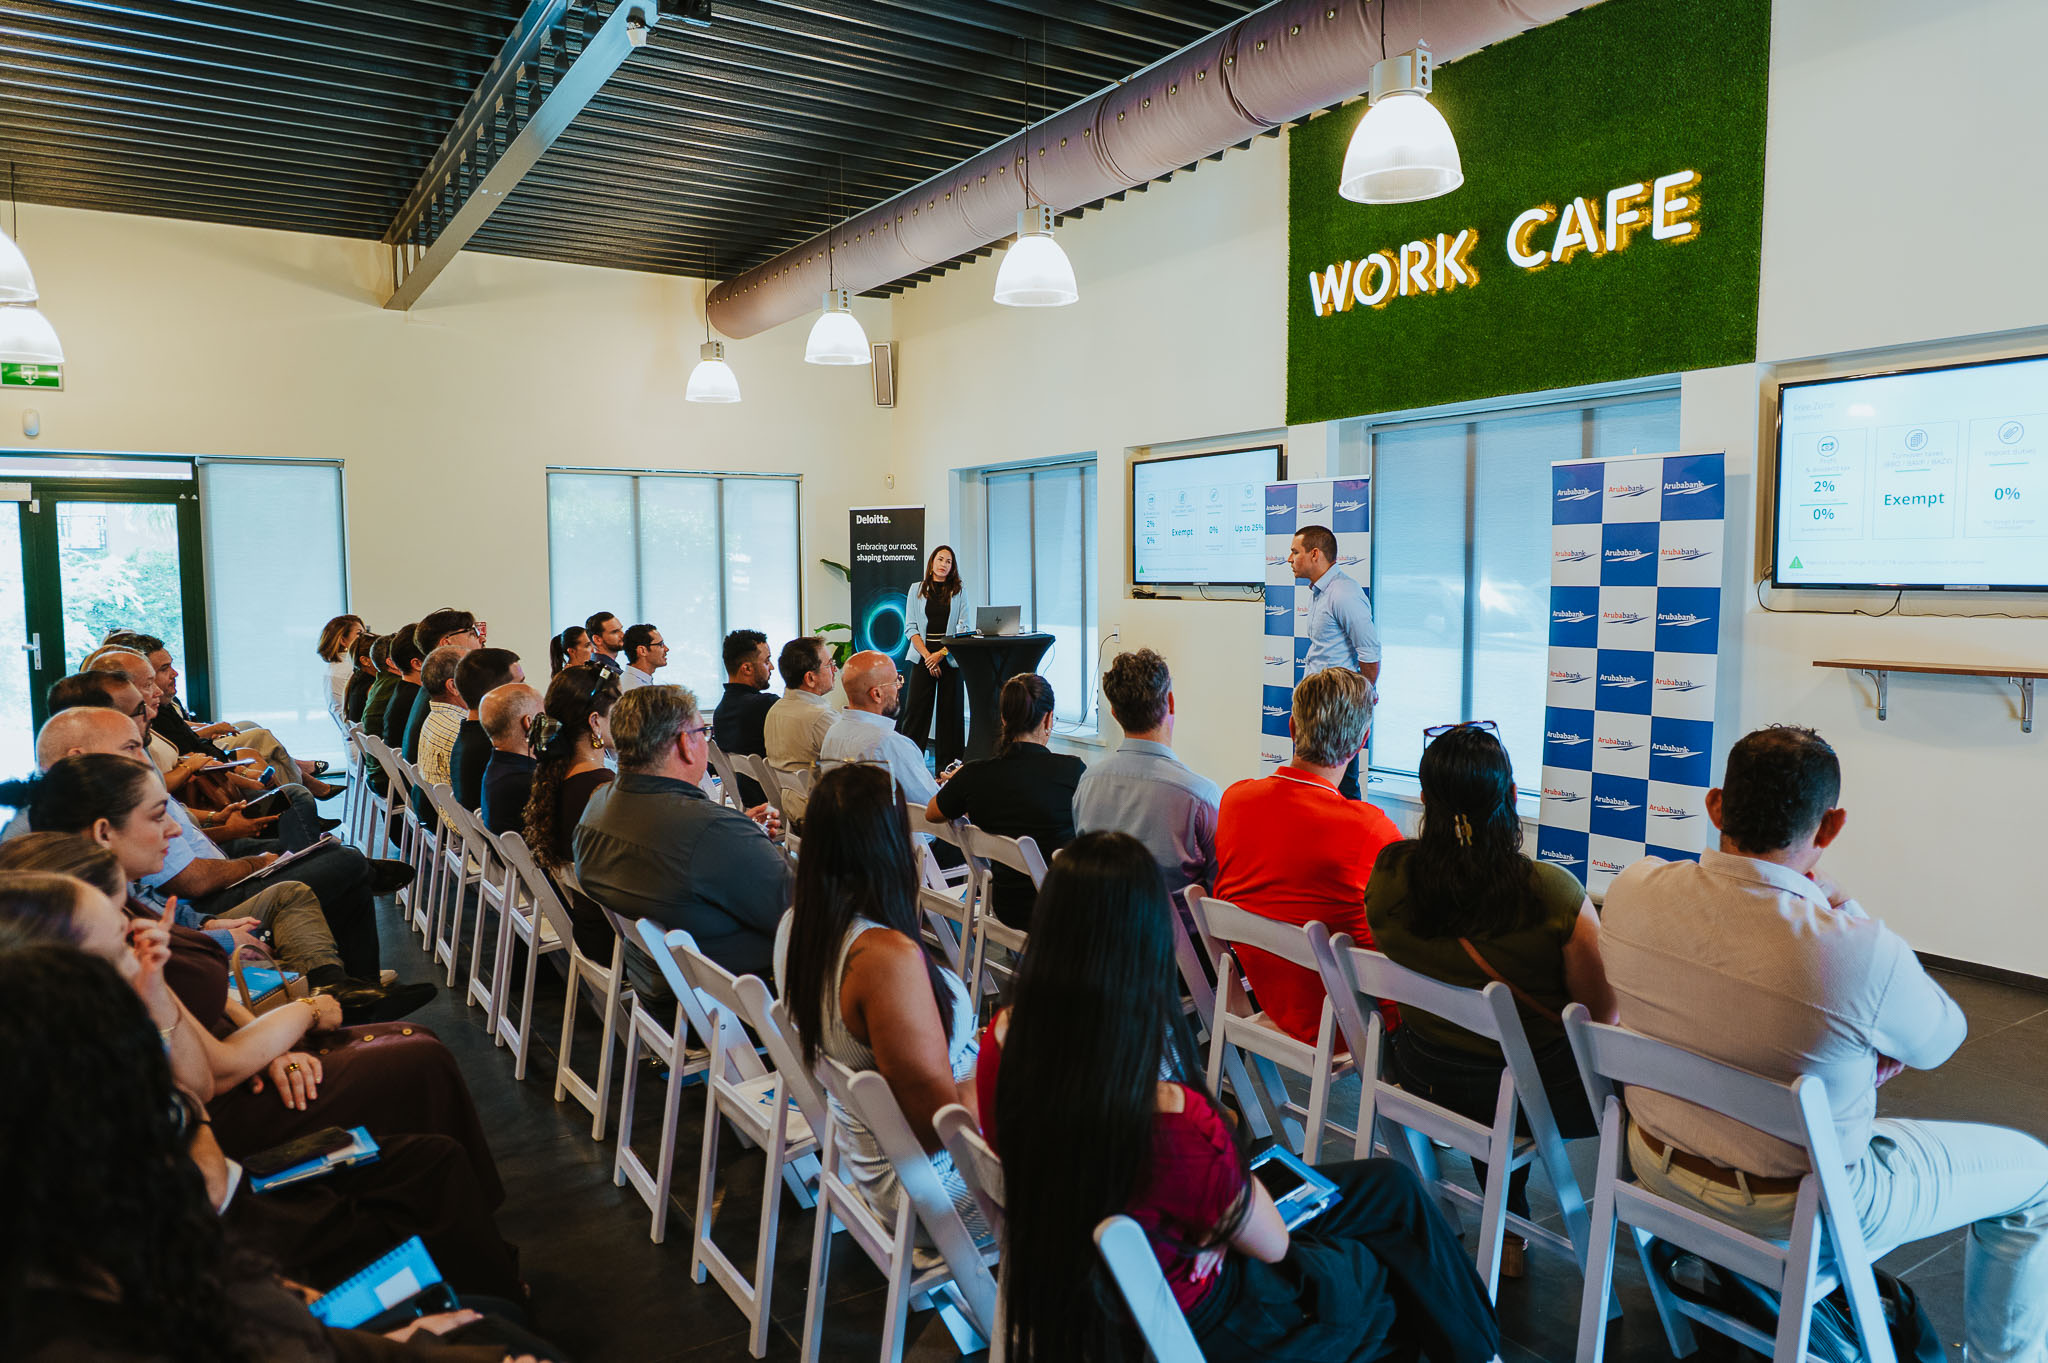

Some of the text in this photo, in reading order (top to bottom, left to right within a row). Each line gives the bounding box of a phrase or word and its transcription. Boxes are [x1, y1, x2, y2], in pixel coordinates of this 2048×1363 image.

[1309, 169, 1700, 317] WORK CAFE
[1608, 484, 1644, 493] Arubabank
[1663, 480, 1704, 490] Arubabank
[1813, 480, 1835, 492] 2%
[1557, 487, 1590, 496] Arubabank
[1994, 487, 2021, 501] 0%
[1884, 493, 1945, 508] Exempt
[1813, 508, 1835, 520] 0%
[856, 514, 891, 525] Deloitte.
[1172, 528, 1194, 538] Exempt
[1235, 523, 1264, 533] Up to 25%
[856, 543, 888, 552] Embracing
[900, 543, 918, 551] roots,
[1605, 548, 1641, 557] Arubabank
[1661, 547, 1699, 556] Arubabank
[856, 553, 882, 563] shaping
[1555, 549, 1587, 557] Arubabank
[1553, 610, 1584, 618] Arubabank
[1603, 611, 1639, 620] Arubabank
[1658, 613, 1696, 622] Arubabank
[1550, 670, 1581, 679] Arubabank
[1600, 673, 1635, 682] Arubabank
[1655, 678, 1692, 687] Arubabank
[1547, 730, 1579, 740] Arubabank
[1598, 737, 1633, 747] Arubabank
[1652, 742, 1690, 753] Arubabank
[1544, 787, 1577, 798] Arubabank
[1594, 795, 1630, 806] Arubabank
[1649, 804, 1686, 816] Arubabank
[1541, 849, 1575, 861] Arubabank
